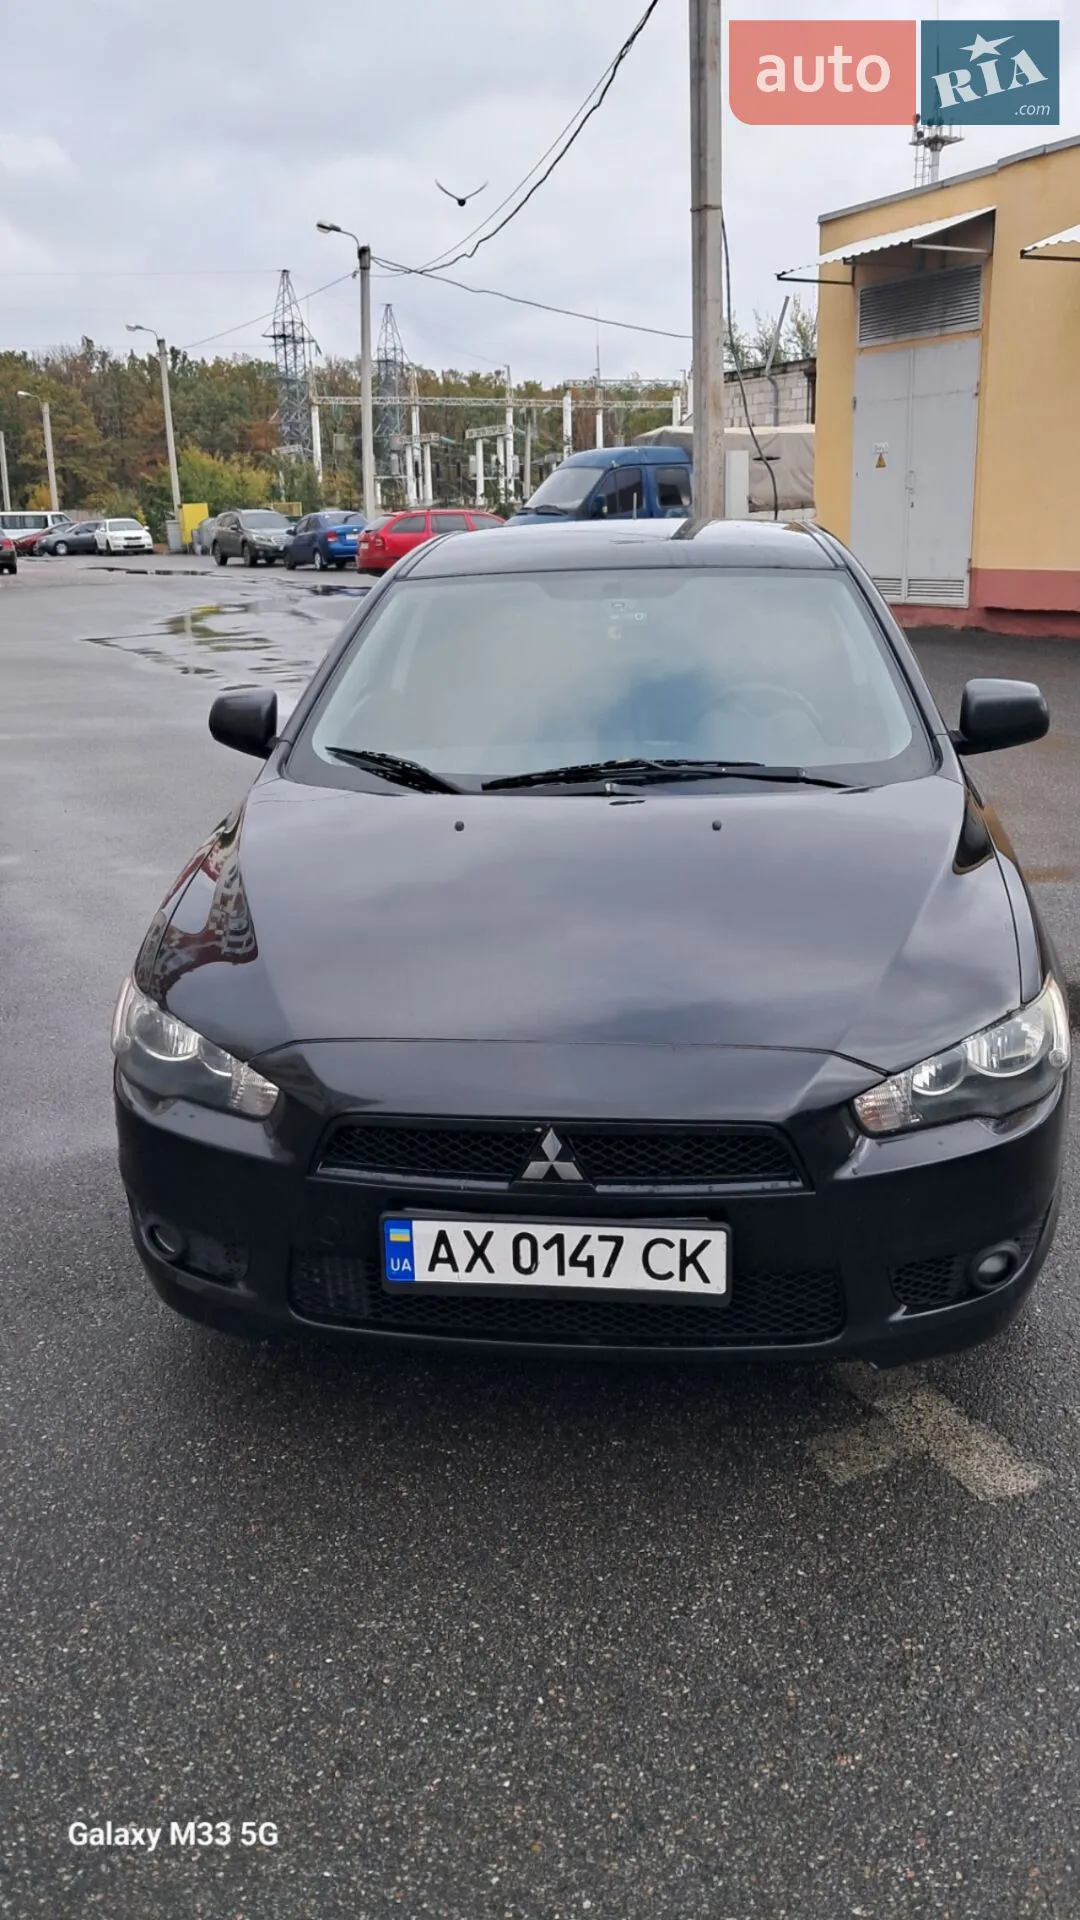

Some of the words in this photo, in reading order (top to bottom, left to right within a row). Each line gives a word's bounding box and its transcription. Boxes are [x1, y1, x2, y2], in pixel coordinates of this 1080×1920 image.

[390, 1258, 412, 1273] UA
[427, 1229, 495, 1274] AX
[511, 1231, 624, 1278] 0147
[641, 1237, 712, 1284] CK
